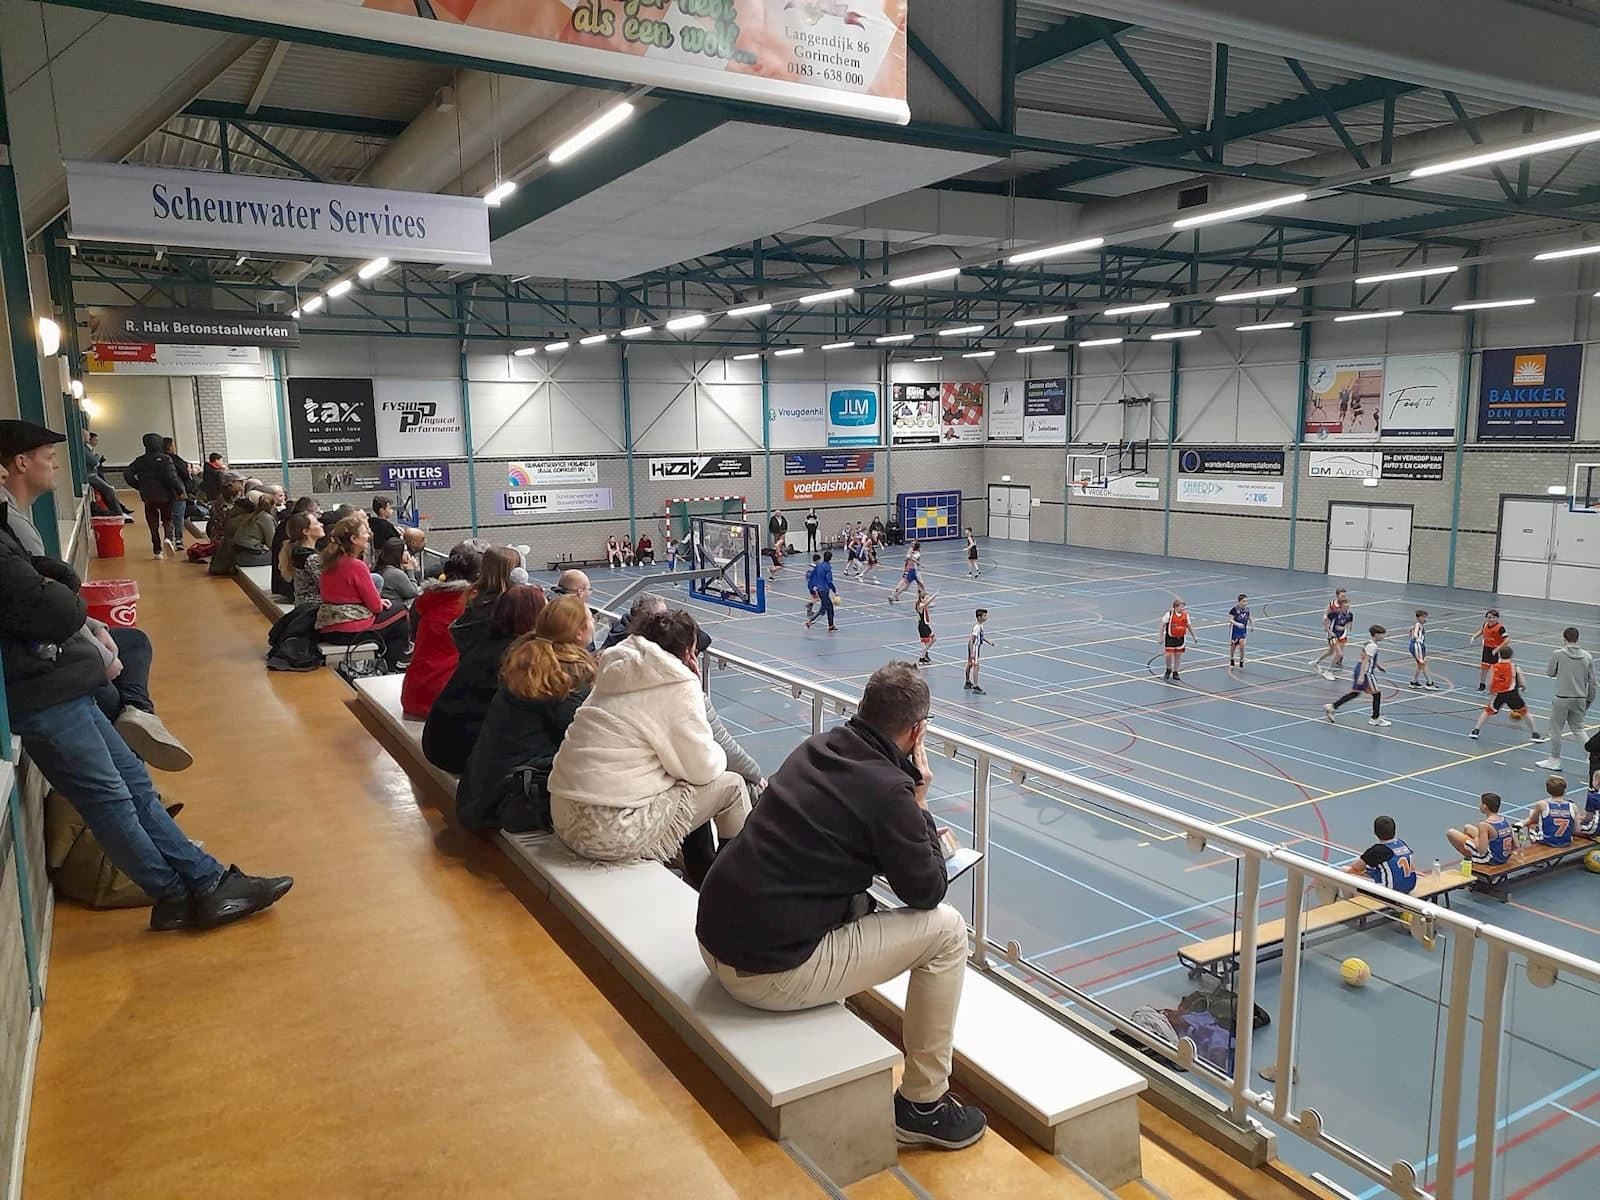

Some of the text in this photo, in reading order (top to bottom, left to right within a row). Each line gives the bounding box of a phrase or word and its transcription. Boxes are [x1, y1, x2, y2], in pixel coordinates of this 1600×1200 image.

[572, 0, 615, 37] als
[623, 17, 675, 49] een
[785, 26, 870, 54] Langendijk 86
[794, 45, 861, 69] Gorinchem
[787, 61, 813, 77] 0183
[823, 68, 842, 82] 638
[845, 73, 864, 86] 000
[152, 183, 426, 239] Scheurwater Services
[125, 320, 289, 338] R. Hak Betonstaalwerken
[1488, 387, 1567, 403] BAKKER
[303, 397, 361, 424] tax
[382, 402, 417, 411] FYSIO
[778, 407, 824, 418] Vreugdenhil
[838, 399, 869, 415] JLM
[1487, 408, 1567, 418] DEN BRABER
[388, 467, 442, 479] PUTTERS
[1311, 467, 1374, 477] DM Auto's
[793, 478, 867, 493] voetbalshop.nl
[1553, 818, 1570, 838] 7
